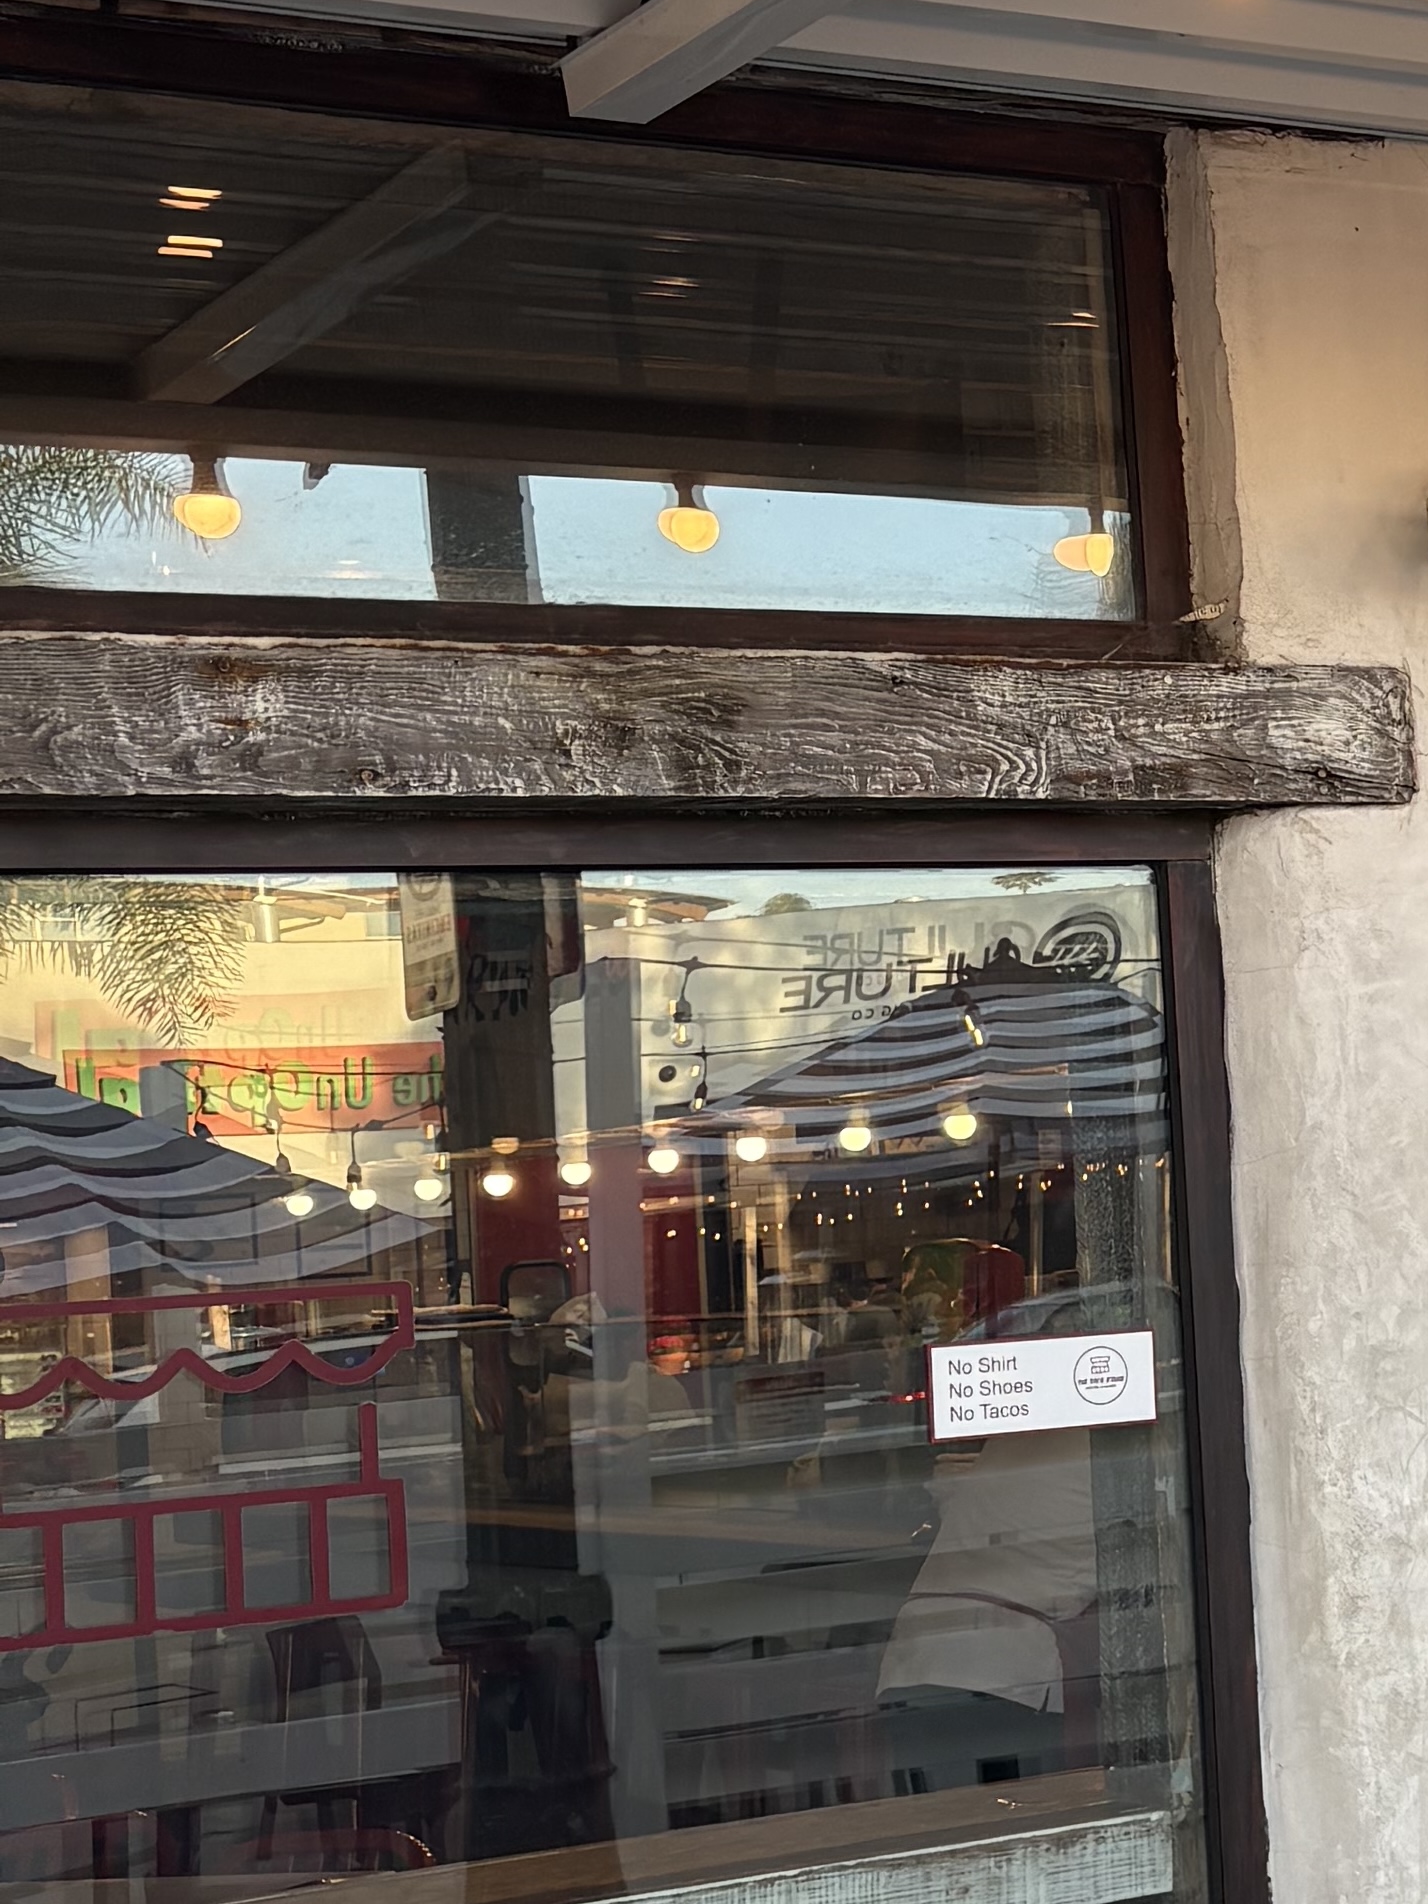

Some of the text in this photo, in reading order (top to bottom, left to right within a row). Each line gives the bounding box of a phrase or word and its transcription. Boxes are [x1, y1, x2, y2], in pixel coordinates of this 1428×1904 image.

[948, 1356, 1018, 1376] No Shirt
[949, 1378, 1034, 1399] No Shoes
[949, 1402, 1030, 1422] No Tacos
